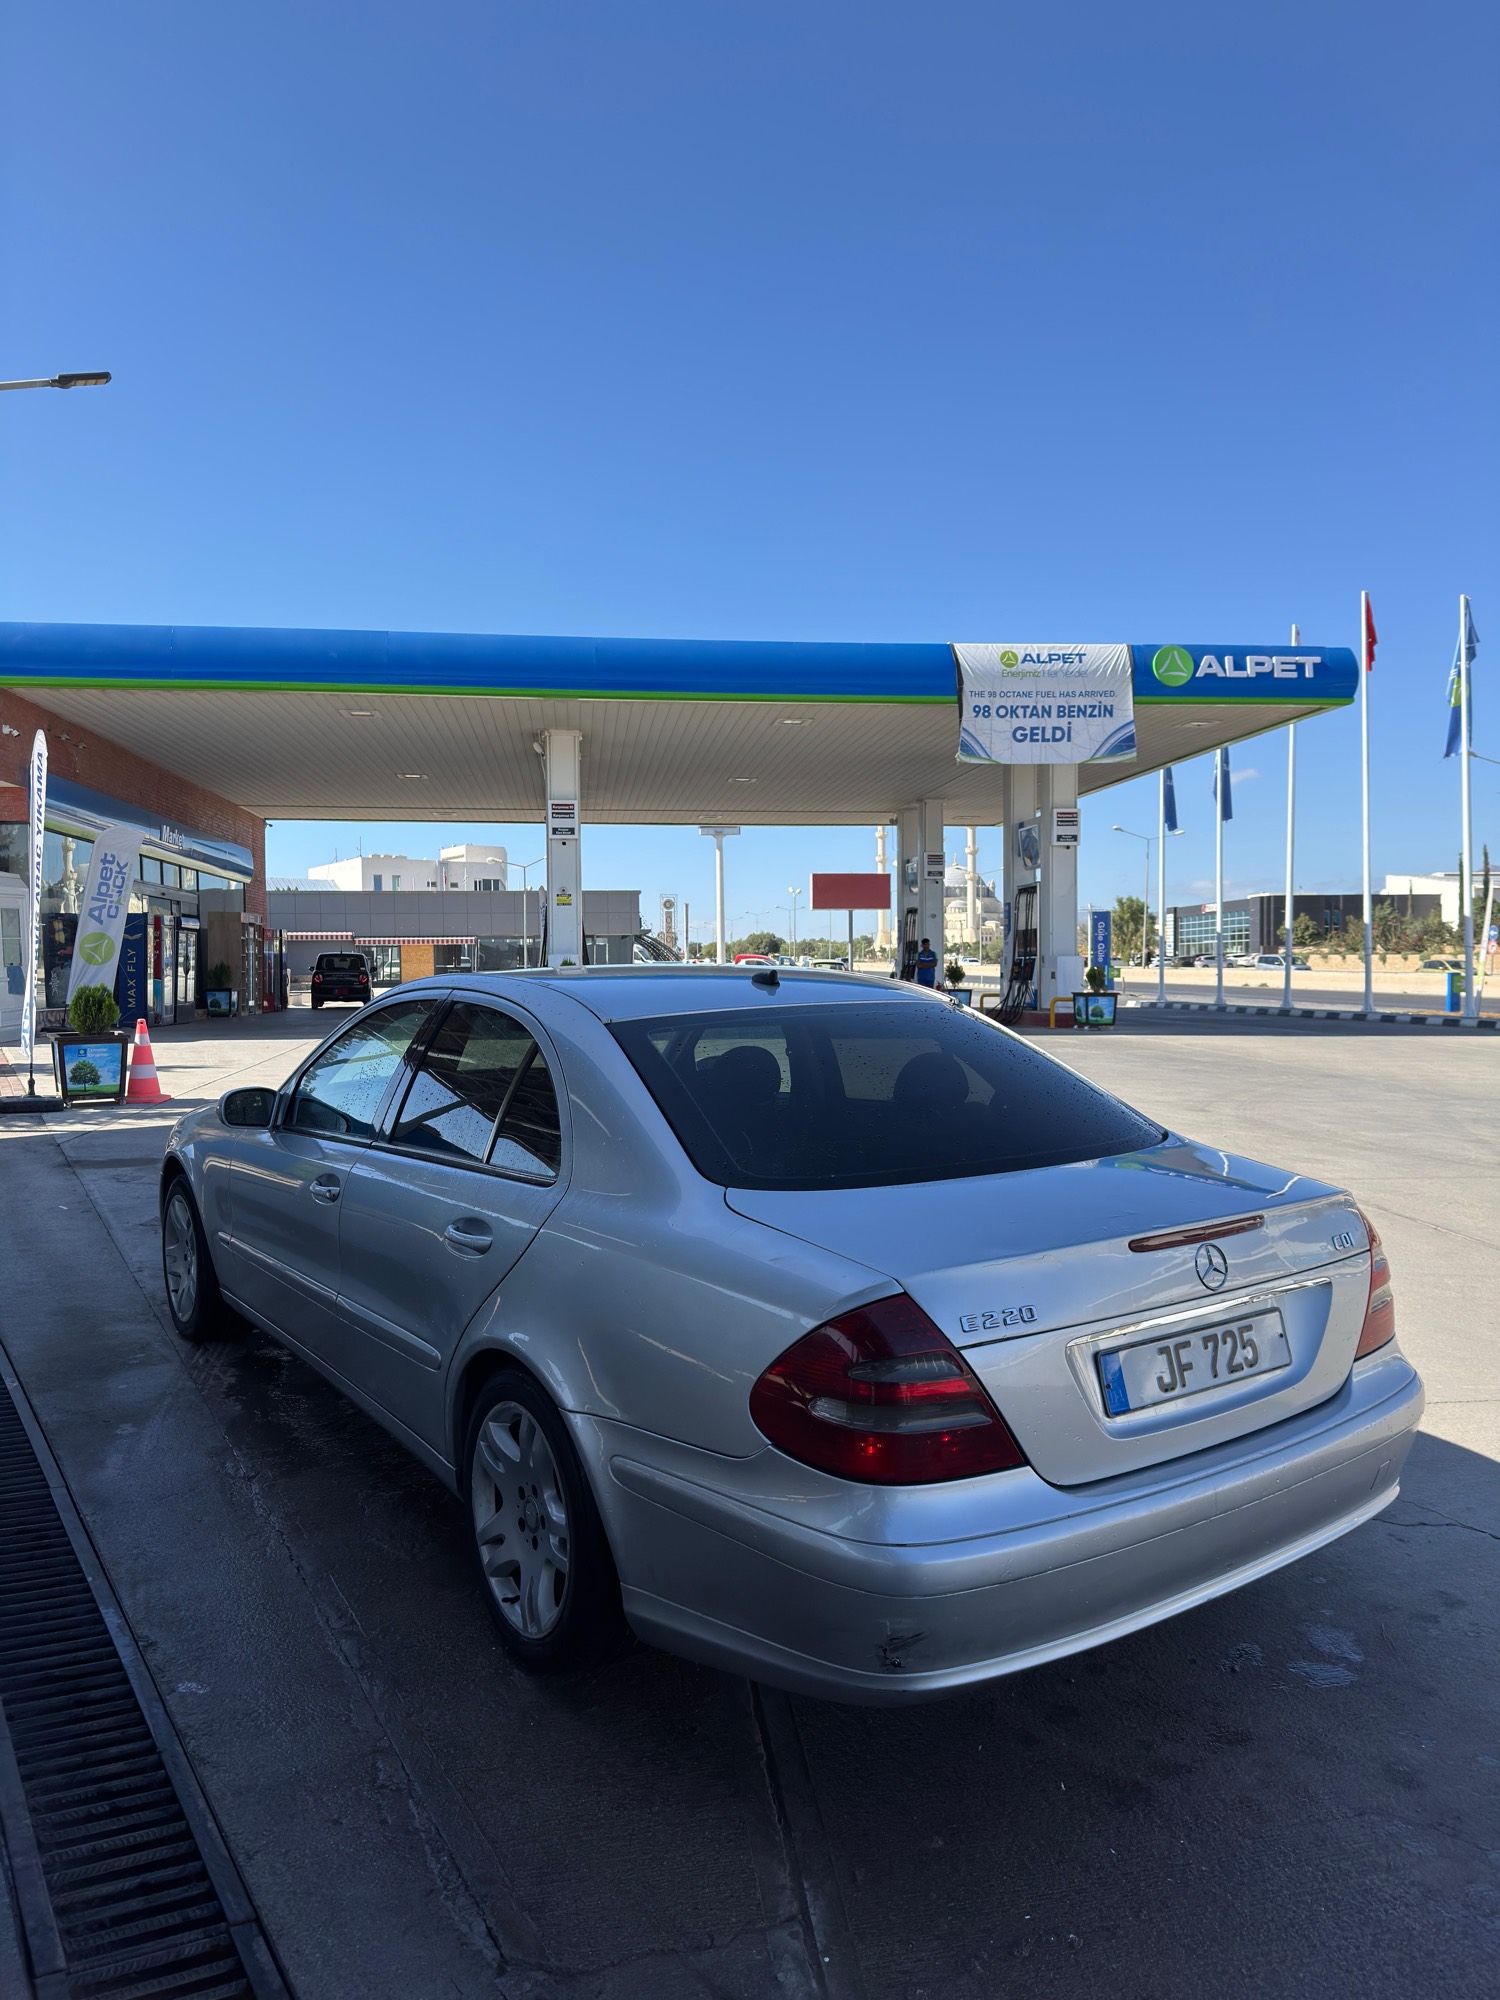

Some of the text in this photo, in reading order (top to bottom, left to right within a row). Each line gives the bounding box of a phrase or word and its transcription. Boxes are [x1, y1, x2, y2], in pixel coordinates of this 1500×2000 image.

[1020, 652, 1086, 664] ALPET
[1195, 655, 1321, 678] ALPET
[1001, 668, 1041, 680] Enerjimiz
[968, 690, 1118, 698] THE 98 OCTANE FUEL HAS ARRIVED.
[972, 701, 1114, 719] 98 OKTAN BENZİN
[1012, 721, 1072, 743] GELDİ
[36, 751, 44, 838] YIKAMA
[88, 852, 116, 926] Alpet
[127, 949, 137, 1008] MAX FLY
[1331, 1232, 1356, 1251] CDI
[1157, 1324, 1259, 1393] JF 725
